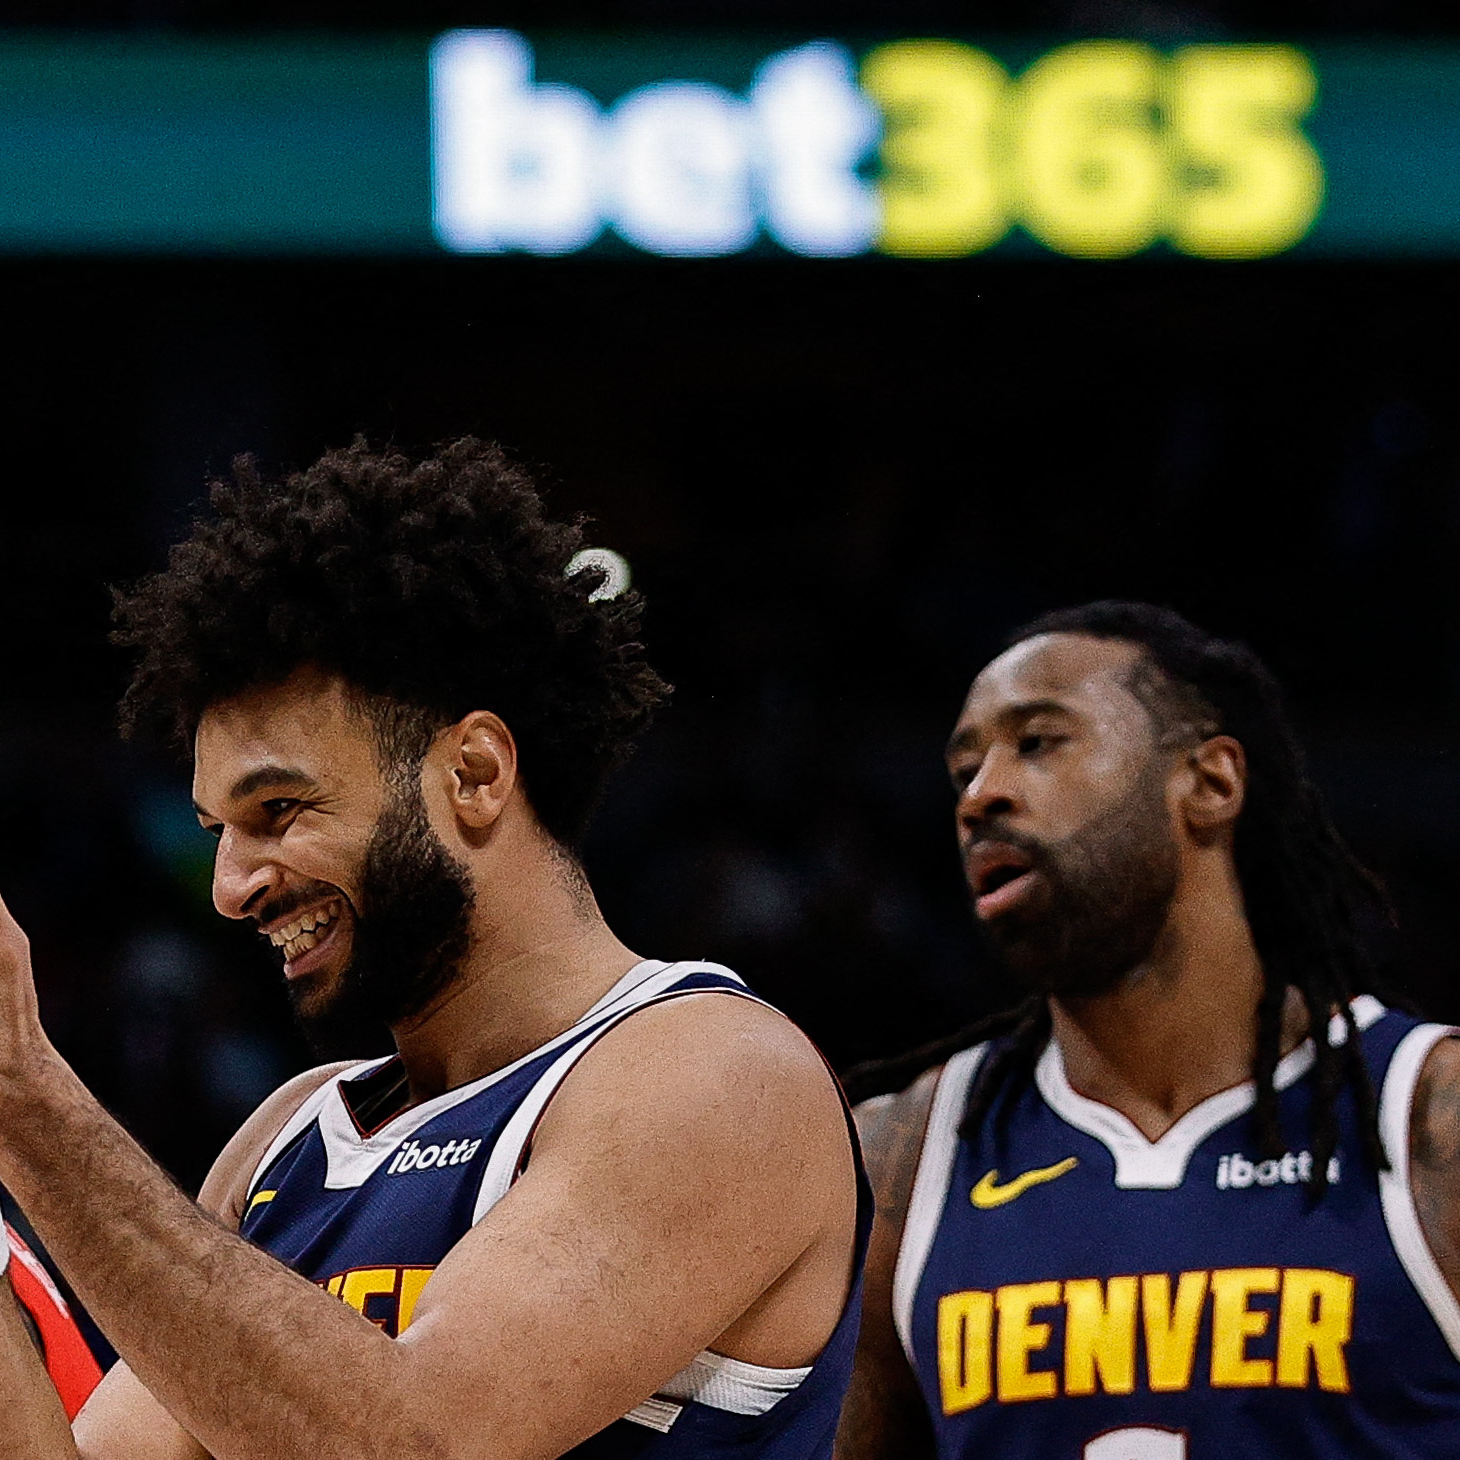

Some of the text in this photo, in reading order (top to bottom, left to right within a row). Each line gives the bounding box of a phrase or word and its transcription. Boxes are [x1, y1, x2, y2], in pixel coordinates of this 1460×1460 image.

[429, 28, 1325, 260] bet365
[386, 1138, 482, 1175] ibotta
[937, 1266, 1356, 1418] DENVER
